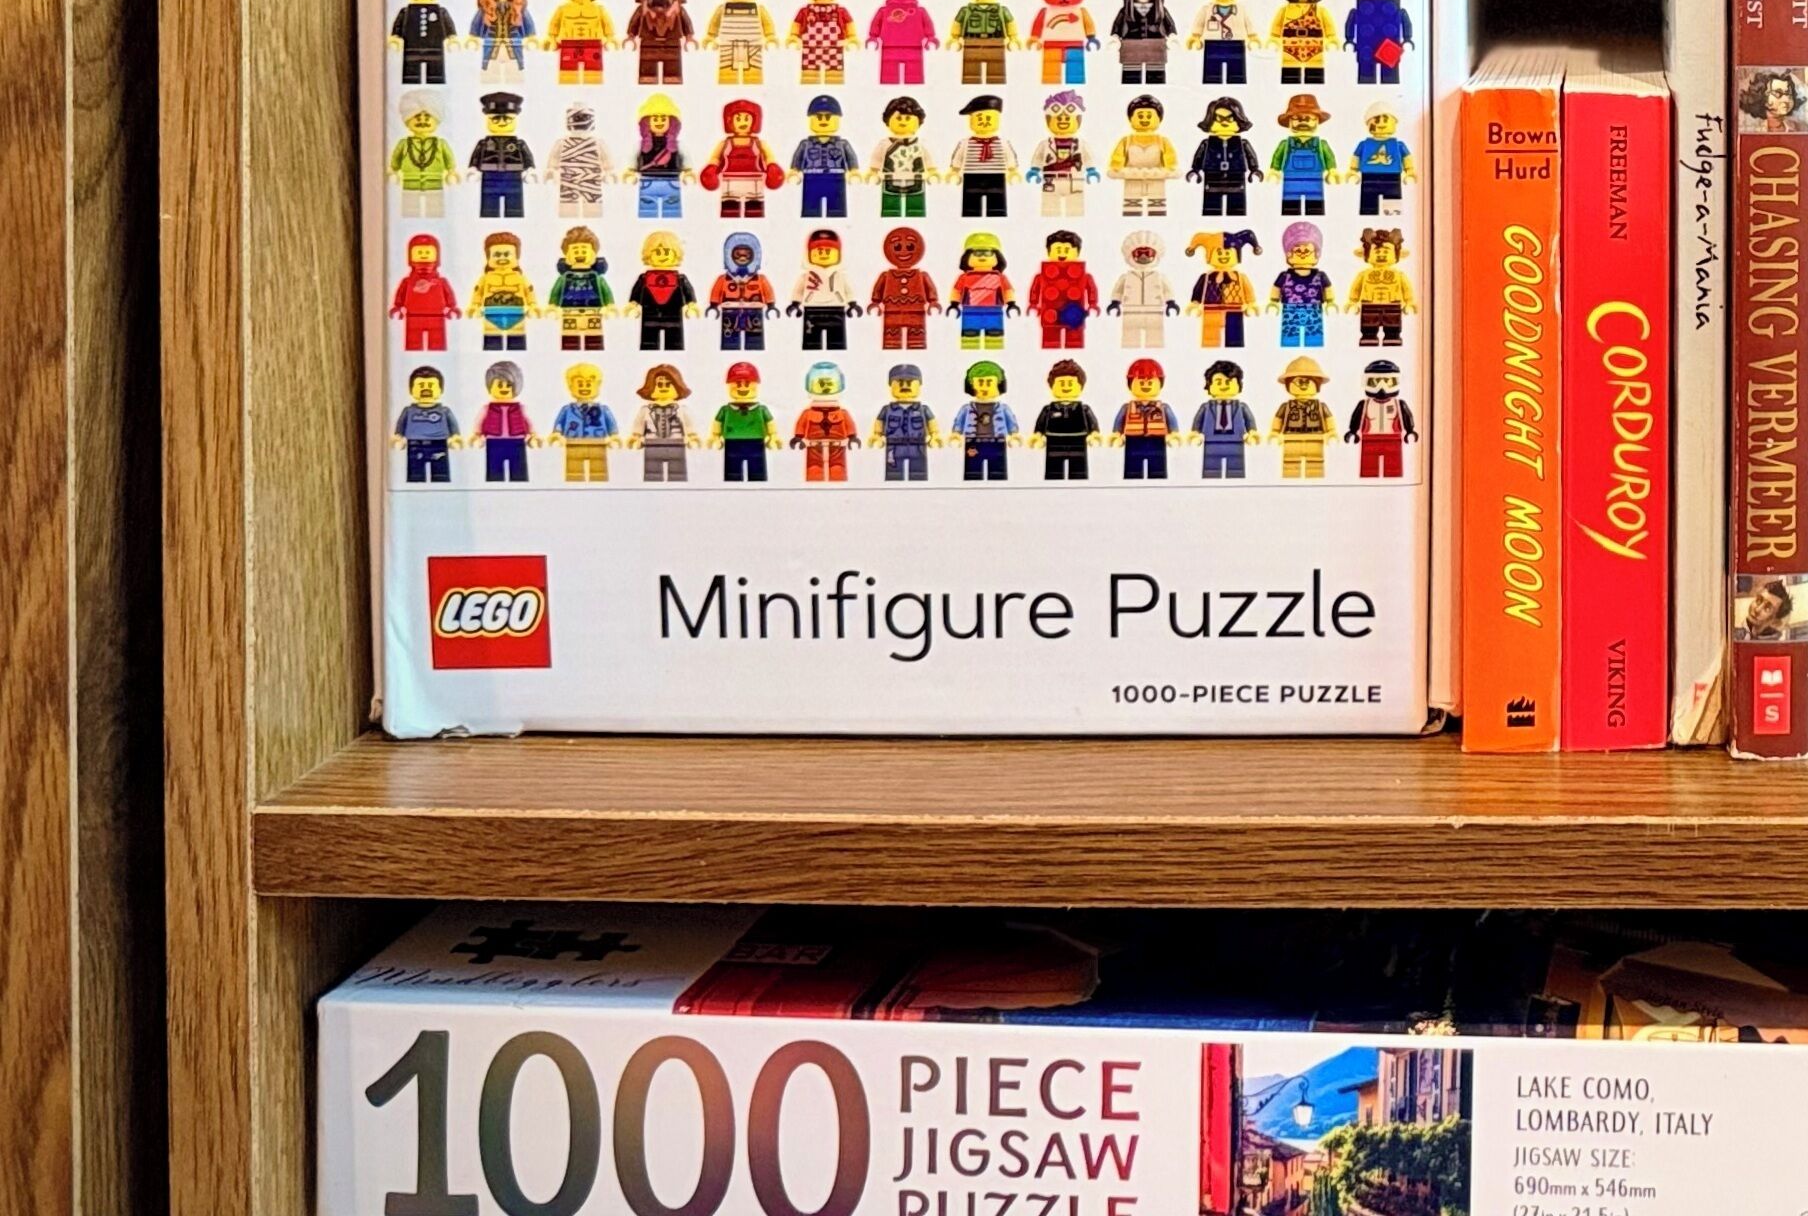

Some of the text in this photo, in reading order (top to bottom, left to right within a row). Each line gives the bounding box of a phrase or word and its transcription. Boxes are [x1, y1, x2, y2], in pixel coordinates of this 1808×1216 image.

[1488, 122, 1557, 145] Brown
[1494, 158, 1551, 180] Hurd
[1609, 125, 1628, 241] FREEMAN
[1680, 112, 1728, 330] Fudge-a-Mania
[1747, 146, 1801, 563] CHASING VERMEER
[1502, 224, 1545, 628] GOODNIGHT MOON
[1570, 300, 1653, 560] CORDUROY
[434, 585, 544, 636] LEGO
[659, 571, 1376, 662] Minifigure Puzzle
[1111, 684, 1383, 704] 1000-PIECE PUZZLE
[1607, 638, 1626, 729] VIKING
[899, 1053, 1143, 1123] PIECE
[1517, 1076, 1655, 1103] LAKE COMO,
[364, 1029, 872, 1216] 1000
[1516, 1109, 1714, 1136] LOMBARDY, ITALY
[892, 1127, 1140, 1183] JIGSAW
[1513, 1146, 1636, 1169] JIGSAW SIZE:
[1514, 1175, 1657, 1199] 690mm x 546mm
